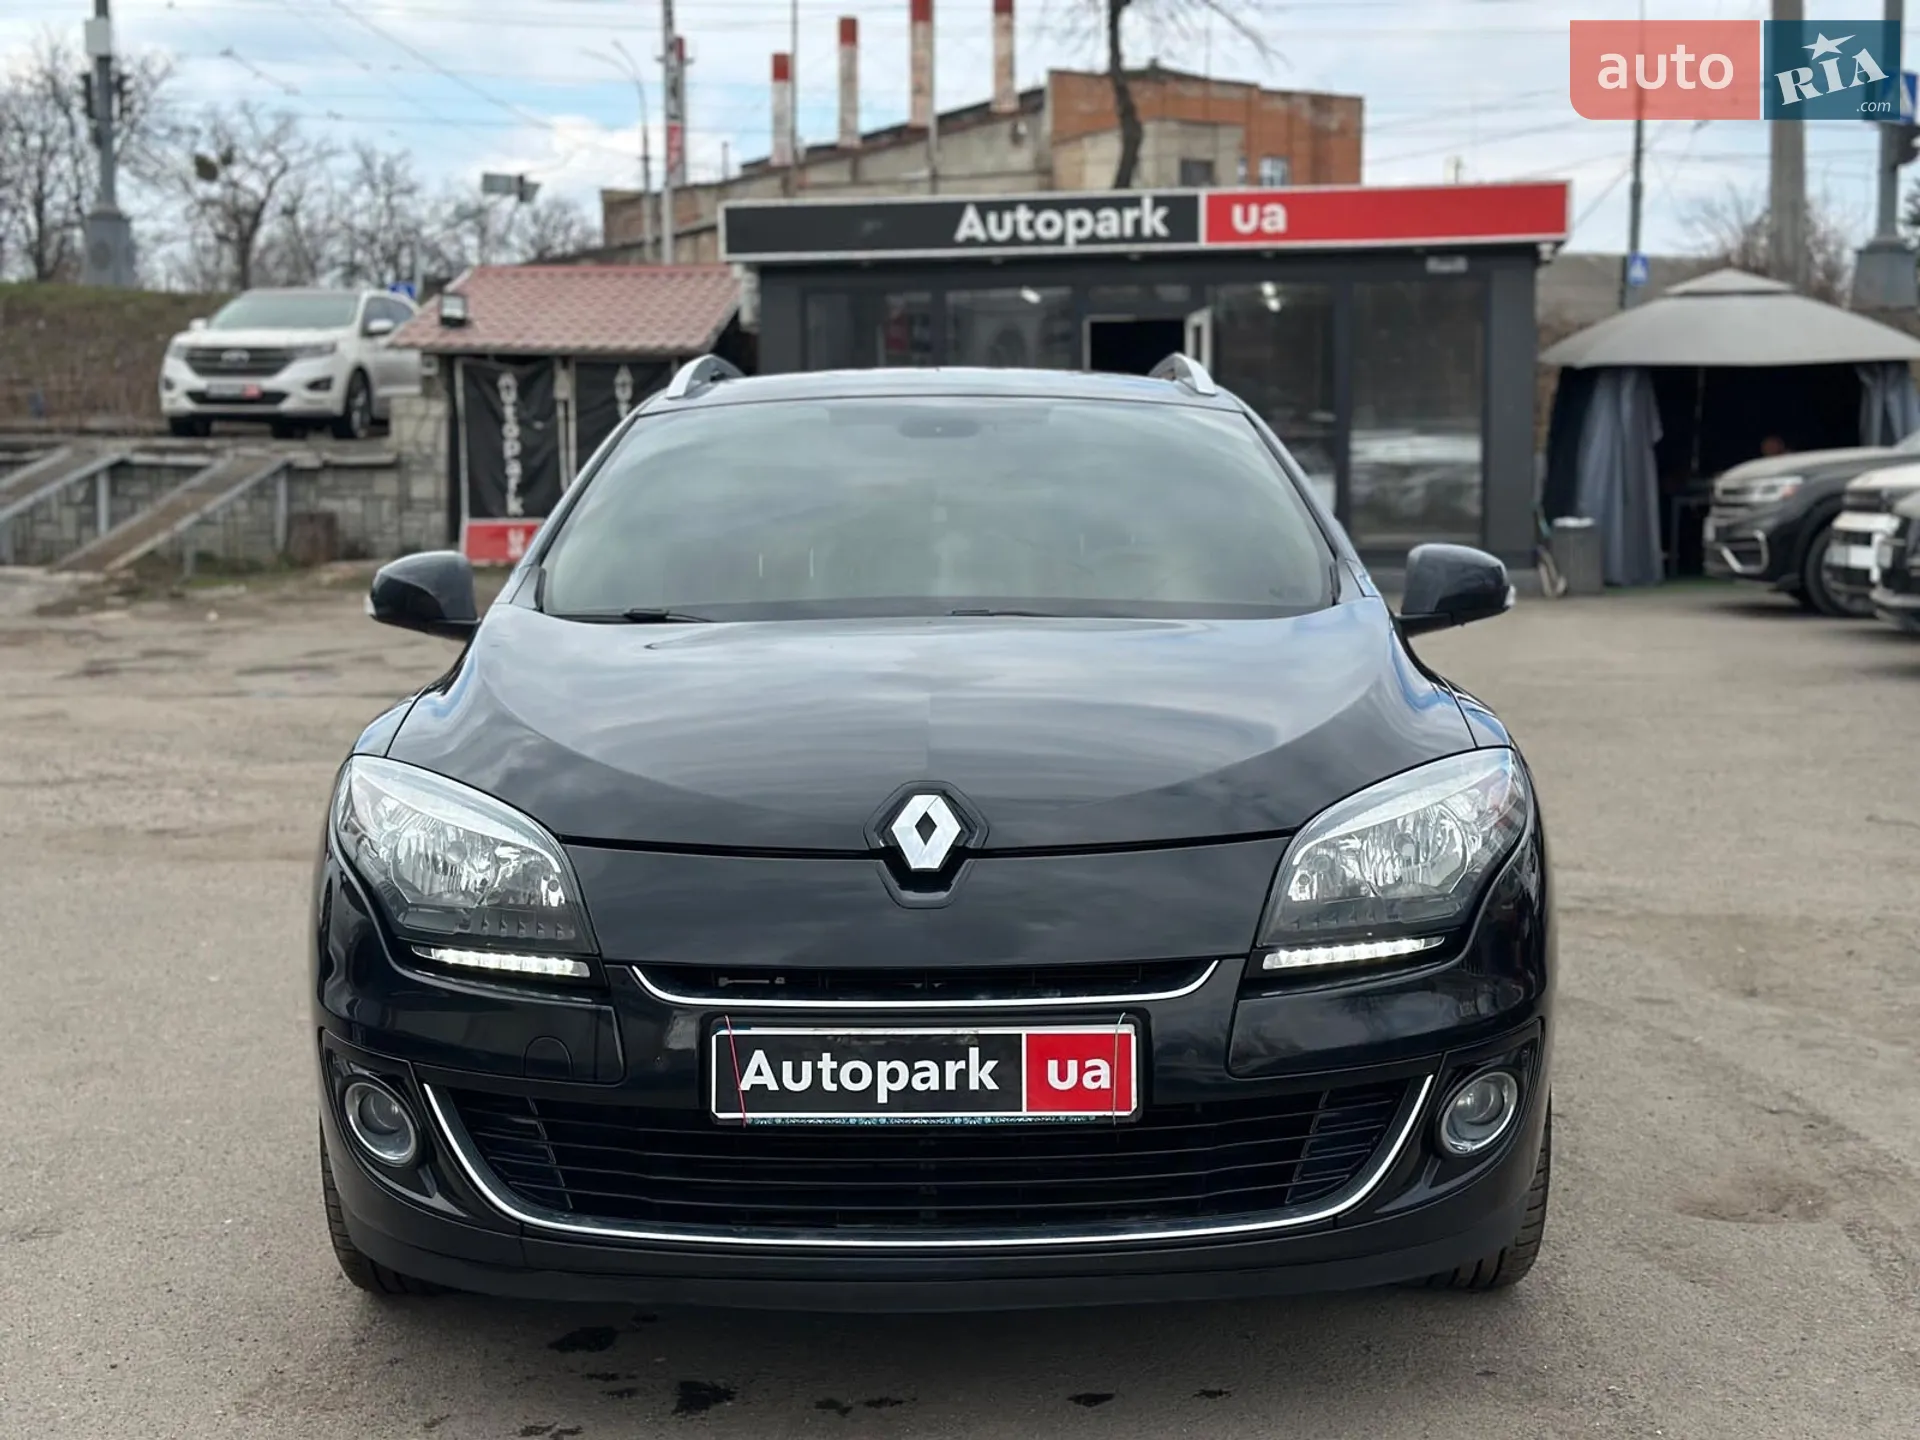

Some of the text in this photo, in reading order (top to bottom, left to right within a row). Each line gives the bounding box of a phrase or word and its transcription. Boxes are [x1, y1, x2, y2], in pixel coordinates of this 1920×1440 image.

[954, 195, 1287, 248] Autopark ua
[739, 1046, 1111, 1104] Autopark ua
